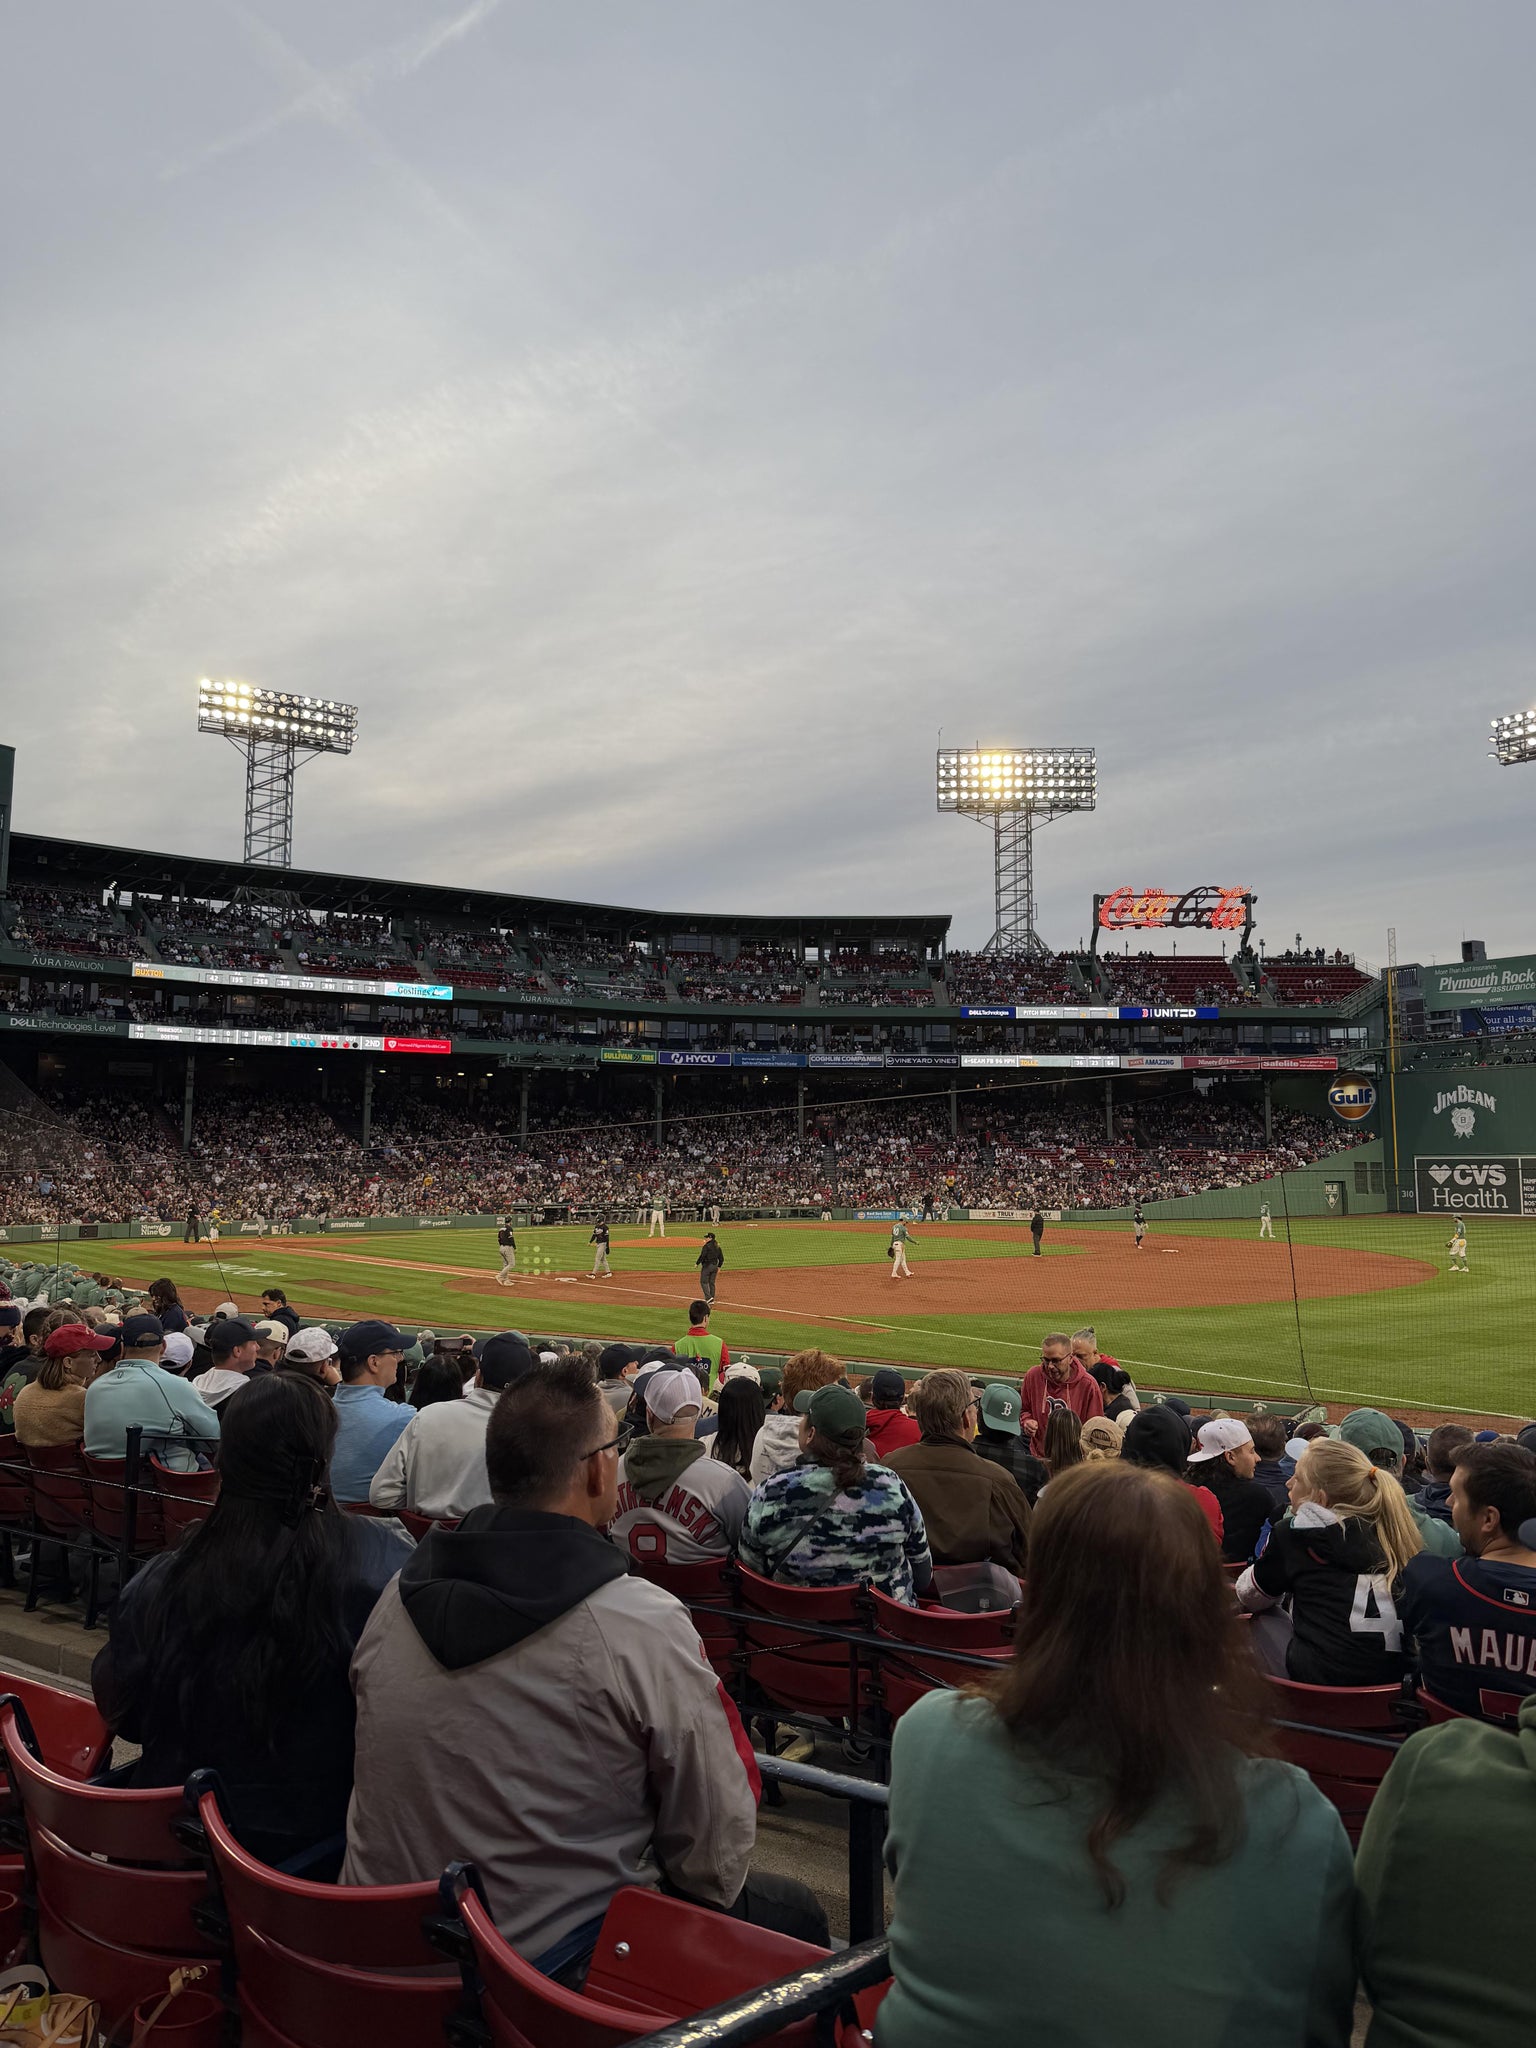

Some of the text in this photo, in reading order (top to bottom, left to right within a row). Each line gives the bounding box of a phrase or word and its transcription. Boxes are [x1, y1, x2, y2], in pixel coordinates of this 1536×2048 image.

[64, 960, 104, 970] PAVILION
[135, 969, 164, 977] BUXTON
[1439, 968, 1536, 991] Plymouth Rock
[397, 987, 430, 996] Goslings
[1154, 1009, 1196, 1018] UNITED
[10, 1017, 116, 1032] DELL Technologies Level
[364, 1040, 380, 1048] 2ND
[604, 1051, 632, 1060] SULLIVAN
[686, 1055, 716, 1064] HYCU
[1330, 1088, 1372, 1104] Gulf
[1433, 1085, 1497, 1114] JIM BEAM
[1453, 1164, 1506, 1186] CVS
[1402, 1190, 1414, 1198] 310
[1432, 1188, 1508, 1208] Health
[330, 1221, 366, 1229] smartwater
[1001, 1402, 1012, 1416] B
[1349, 1574, 1404, 1652] 4
